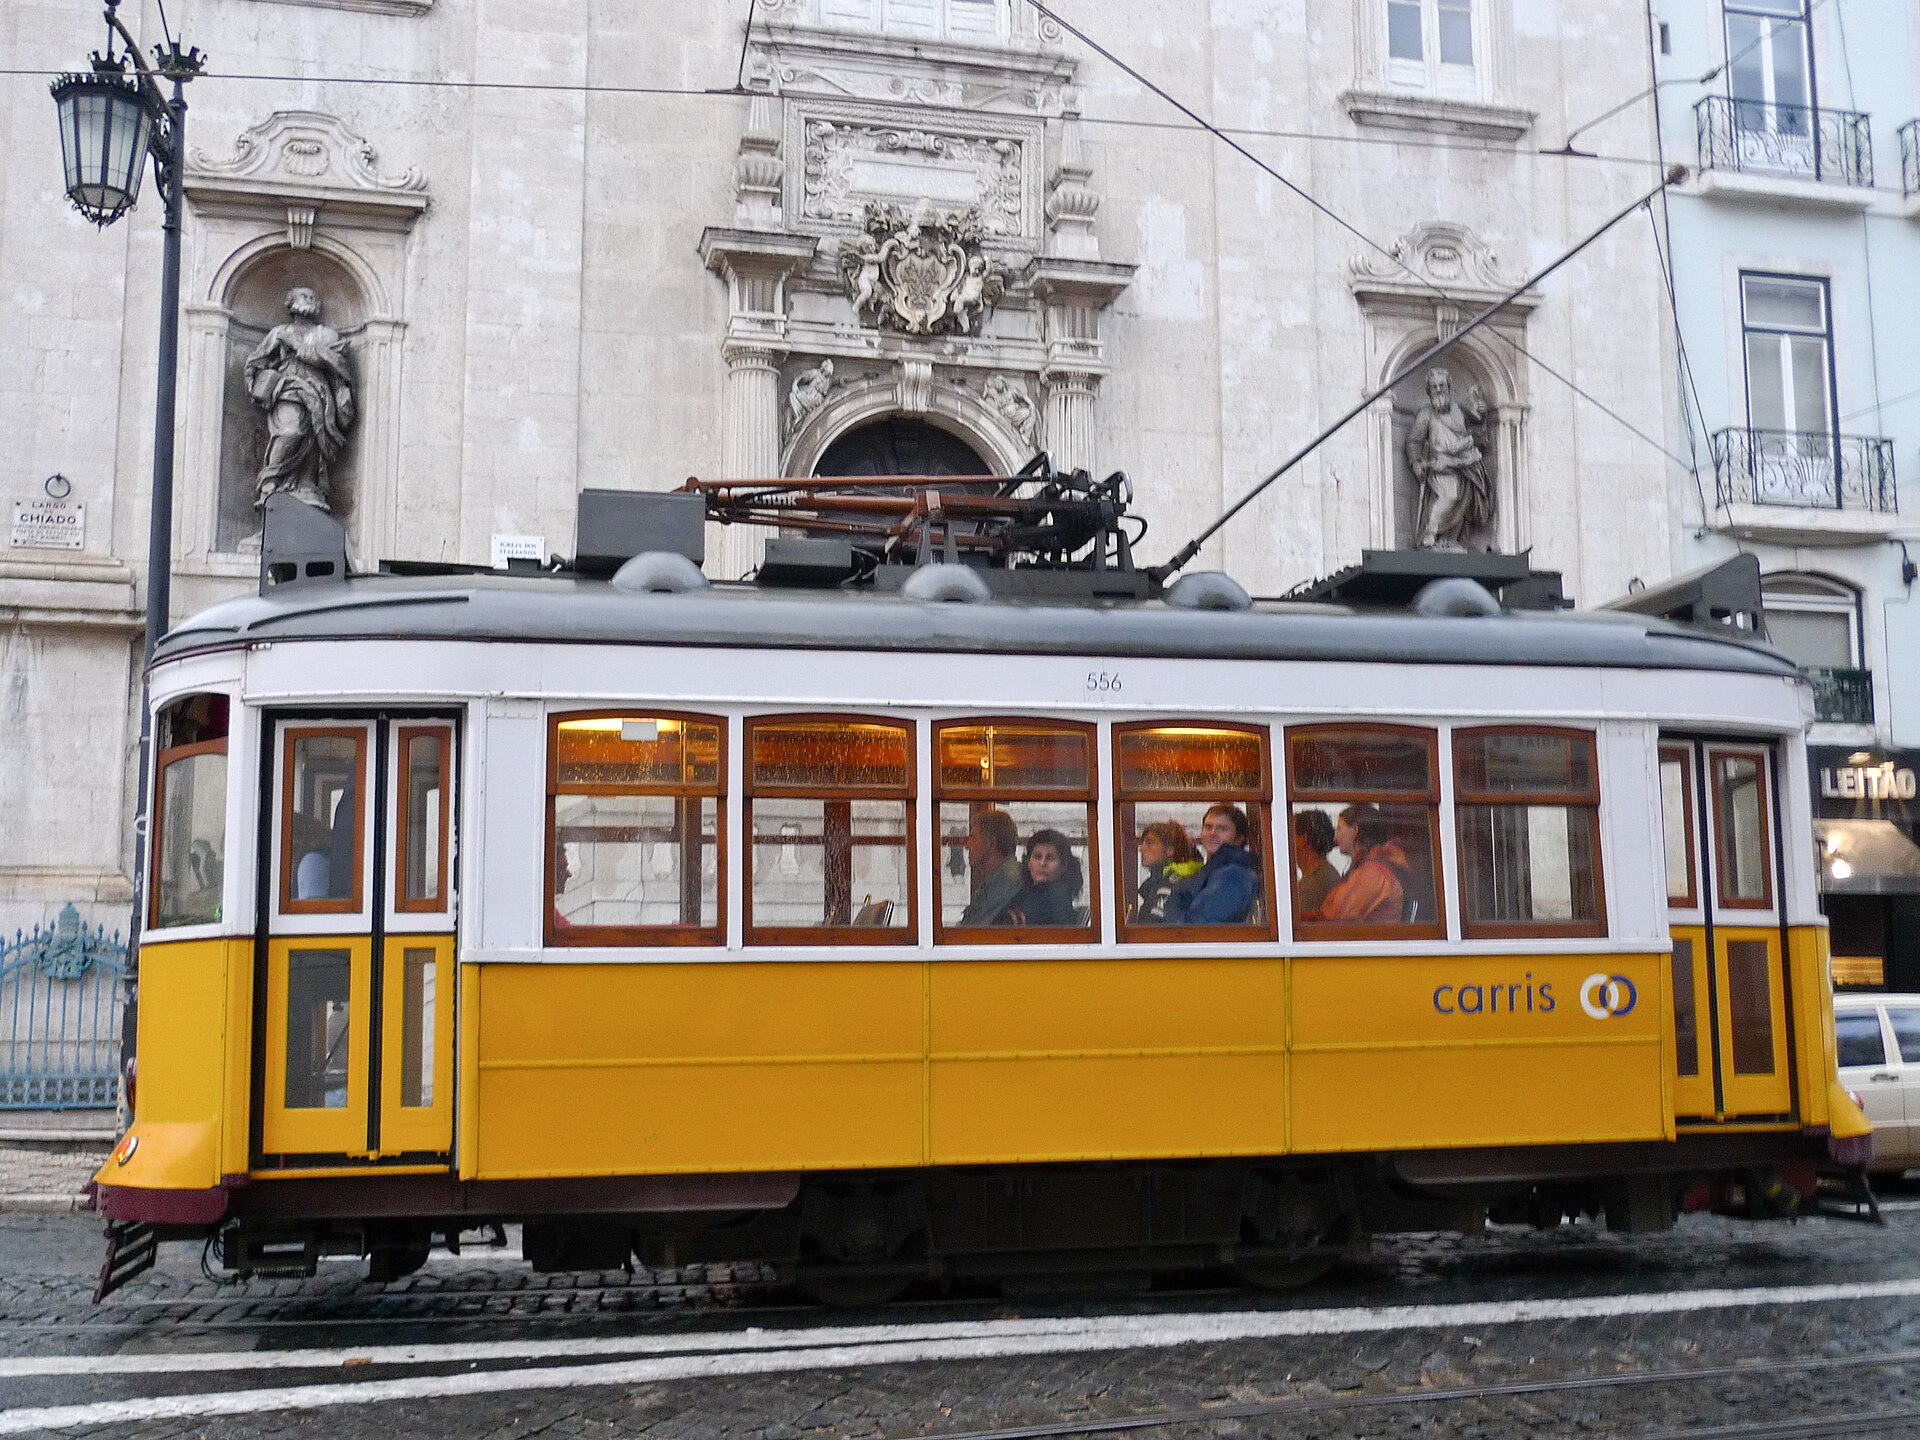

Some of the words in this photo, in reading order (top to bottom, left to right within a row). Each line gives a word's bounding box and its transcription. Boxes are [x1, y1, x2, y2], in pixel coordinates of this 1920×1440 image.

[20, 513, 76, 524] CHIADO
[1087, 672, 1122, 691] 556
[1820, 761, 1916, 799] LEITÃO
[1433, 972, 1555, 1014] carris
